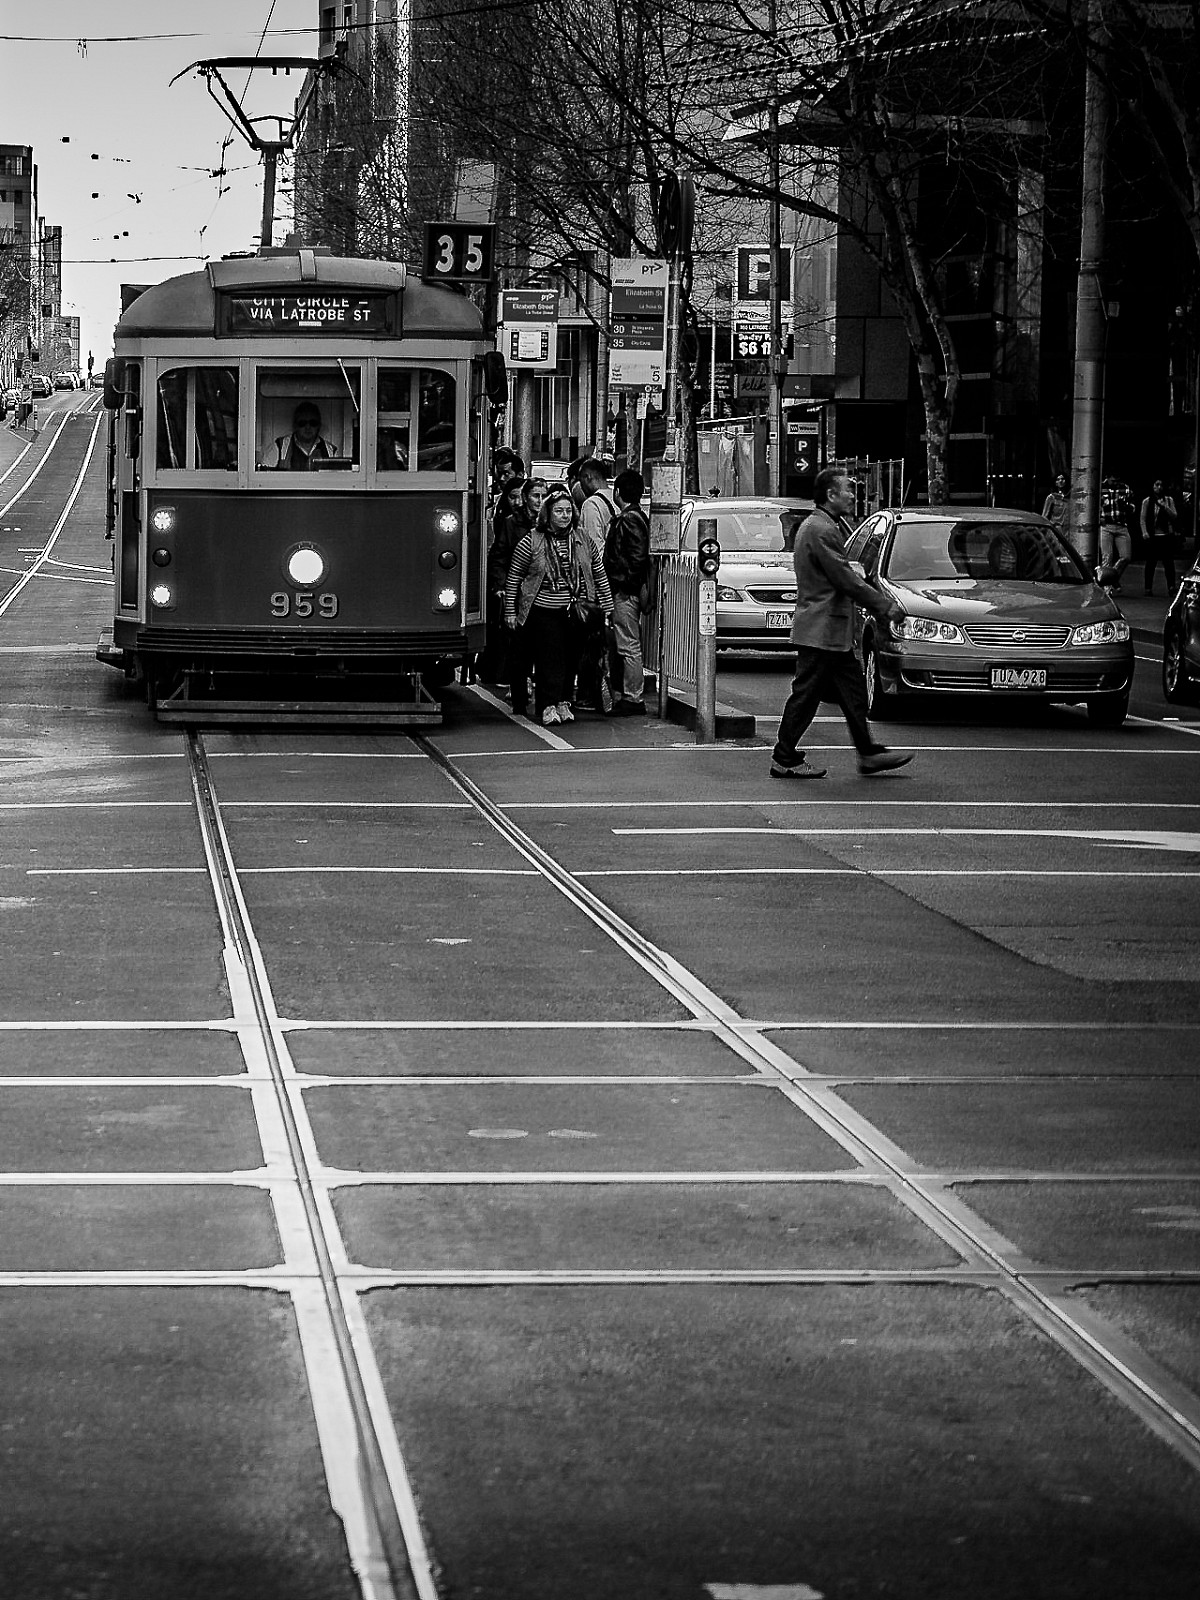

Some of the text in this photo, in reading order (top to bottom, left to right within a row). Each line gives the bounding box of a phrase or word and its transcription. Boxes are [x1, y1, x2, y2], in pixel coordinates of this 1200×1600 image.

[435, 234, 483, 273] 35
[253, 298, 286, 307] CITY
[296, 298, 350, 308] CIRCLE
[250, 307, 371, 321] VIA LATROBE ST
[613, 324, 625, 334] 30
[612, 338, 625, 348] 35
[738, 340, 759, 357] $6
[652, 370, 661, 382] 5
[798, 440, 808, 452] P
[270, 591, 339, 618] 959
[1023, 670, 1045, 684] 928
